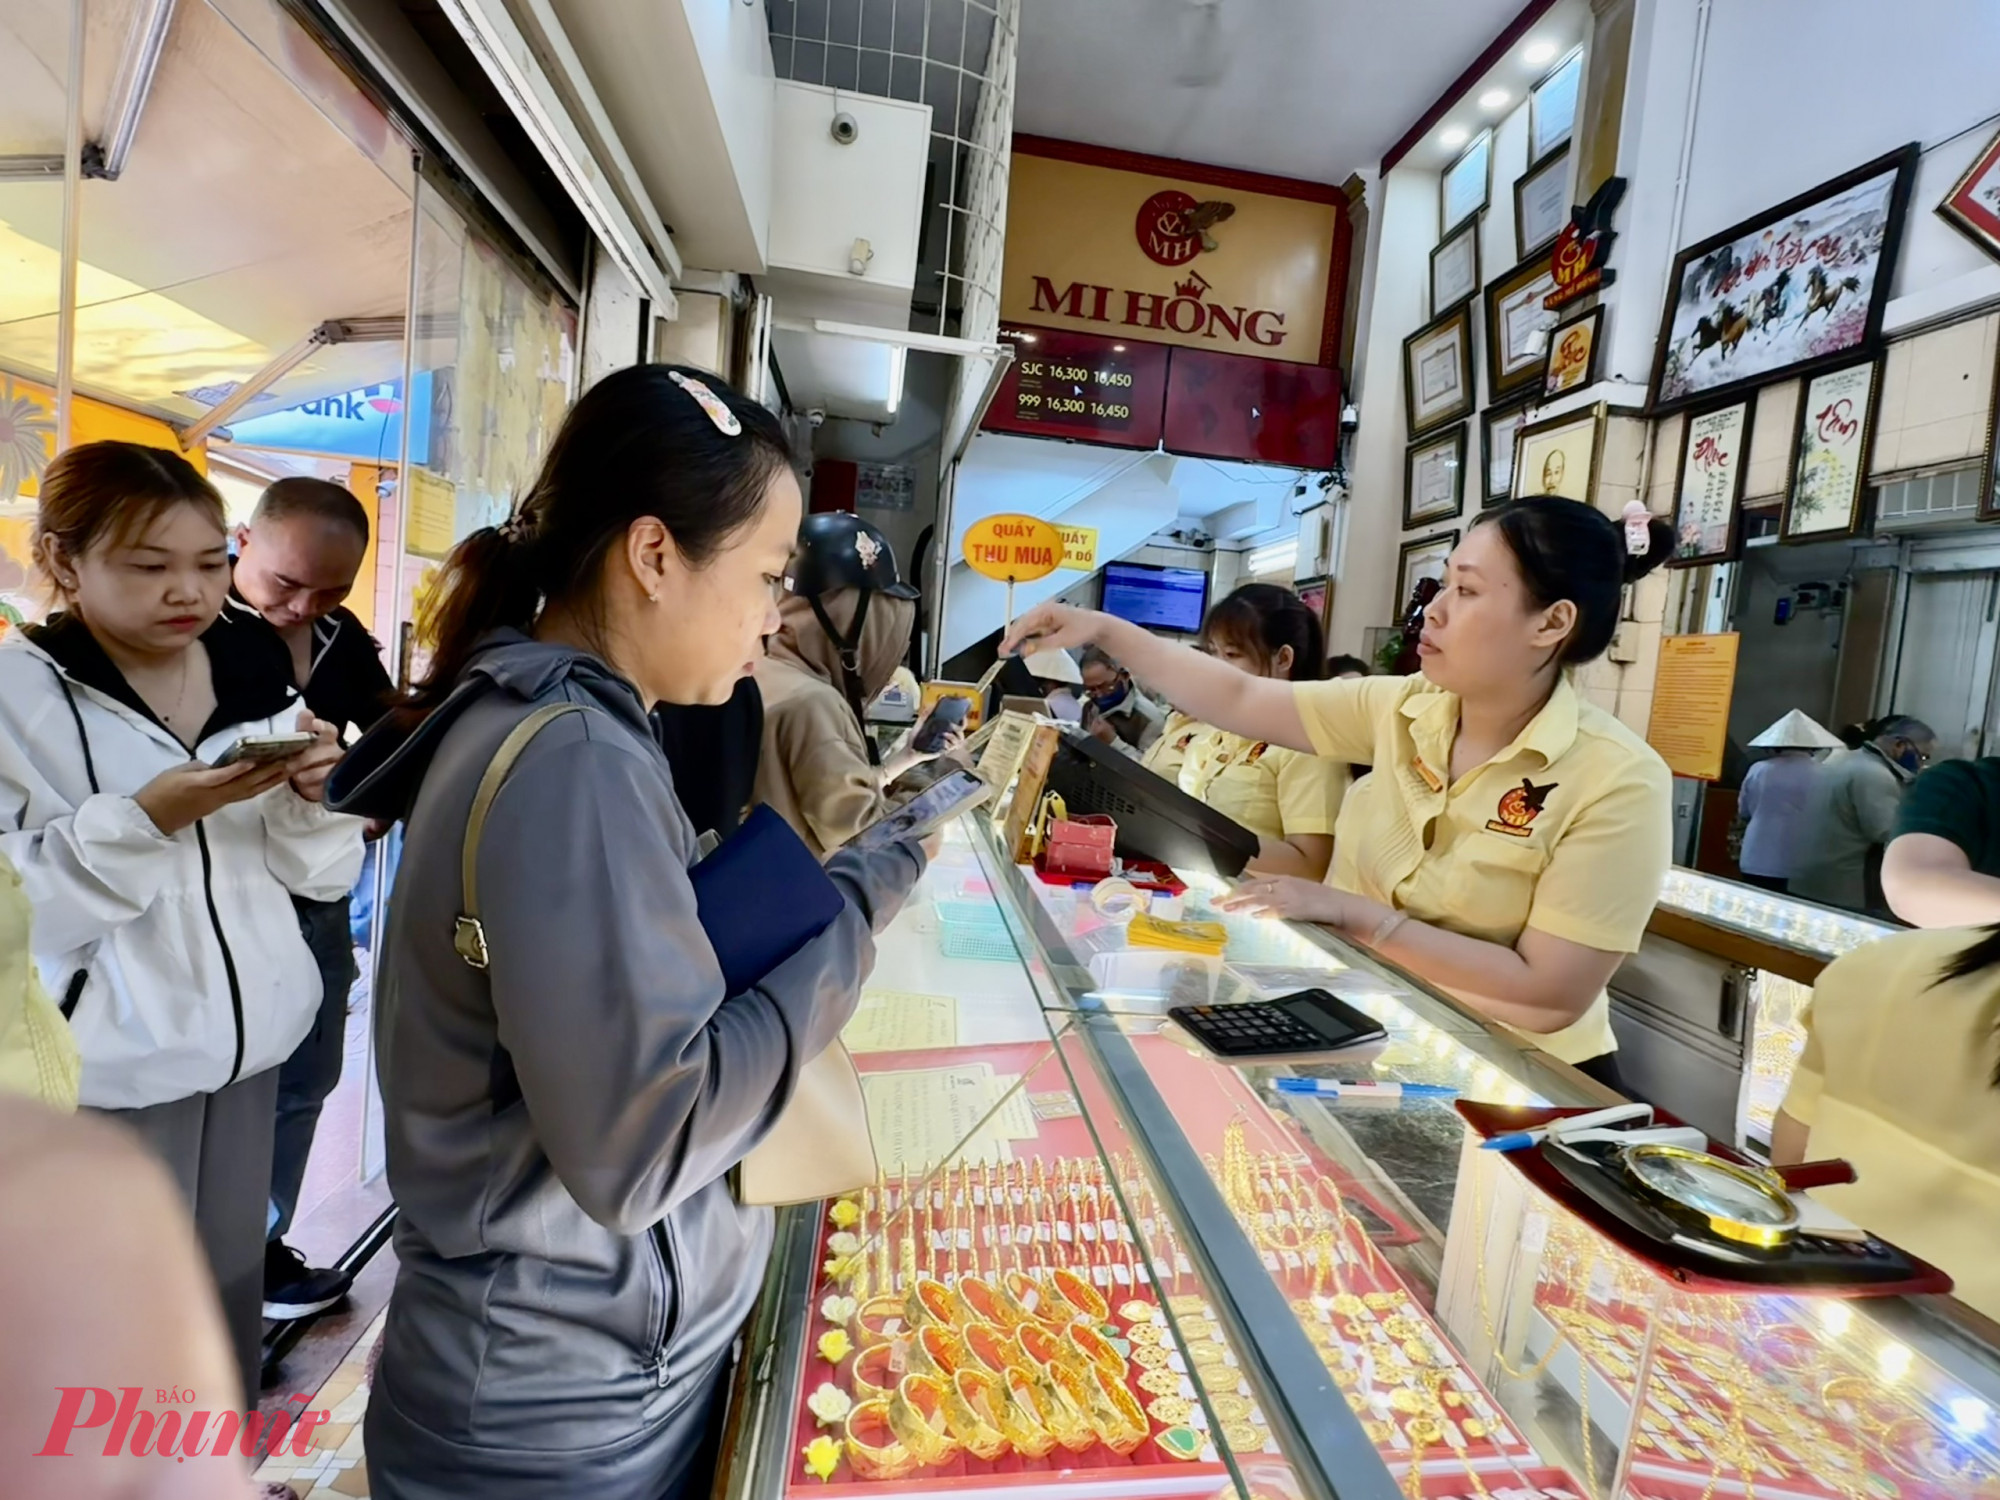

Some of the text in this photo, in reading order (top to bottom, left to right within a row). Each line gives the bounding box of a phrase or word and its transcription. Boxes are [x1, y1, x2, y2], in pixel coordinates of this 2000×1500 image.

[1149, 231, 1193, 260] MH
[1029, 275, 1114, 321] MI
[1021, 362, 1132, 388] SJC 16,300 16,450
[1018, 394, 1129, 418] 999 16,300 16,450
[973, 544, 1053, 566] THU MUA
